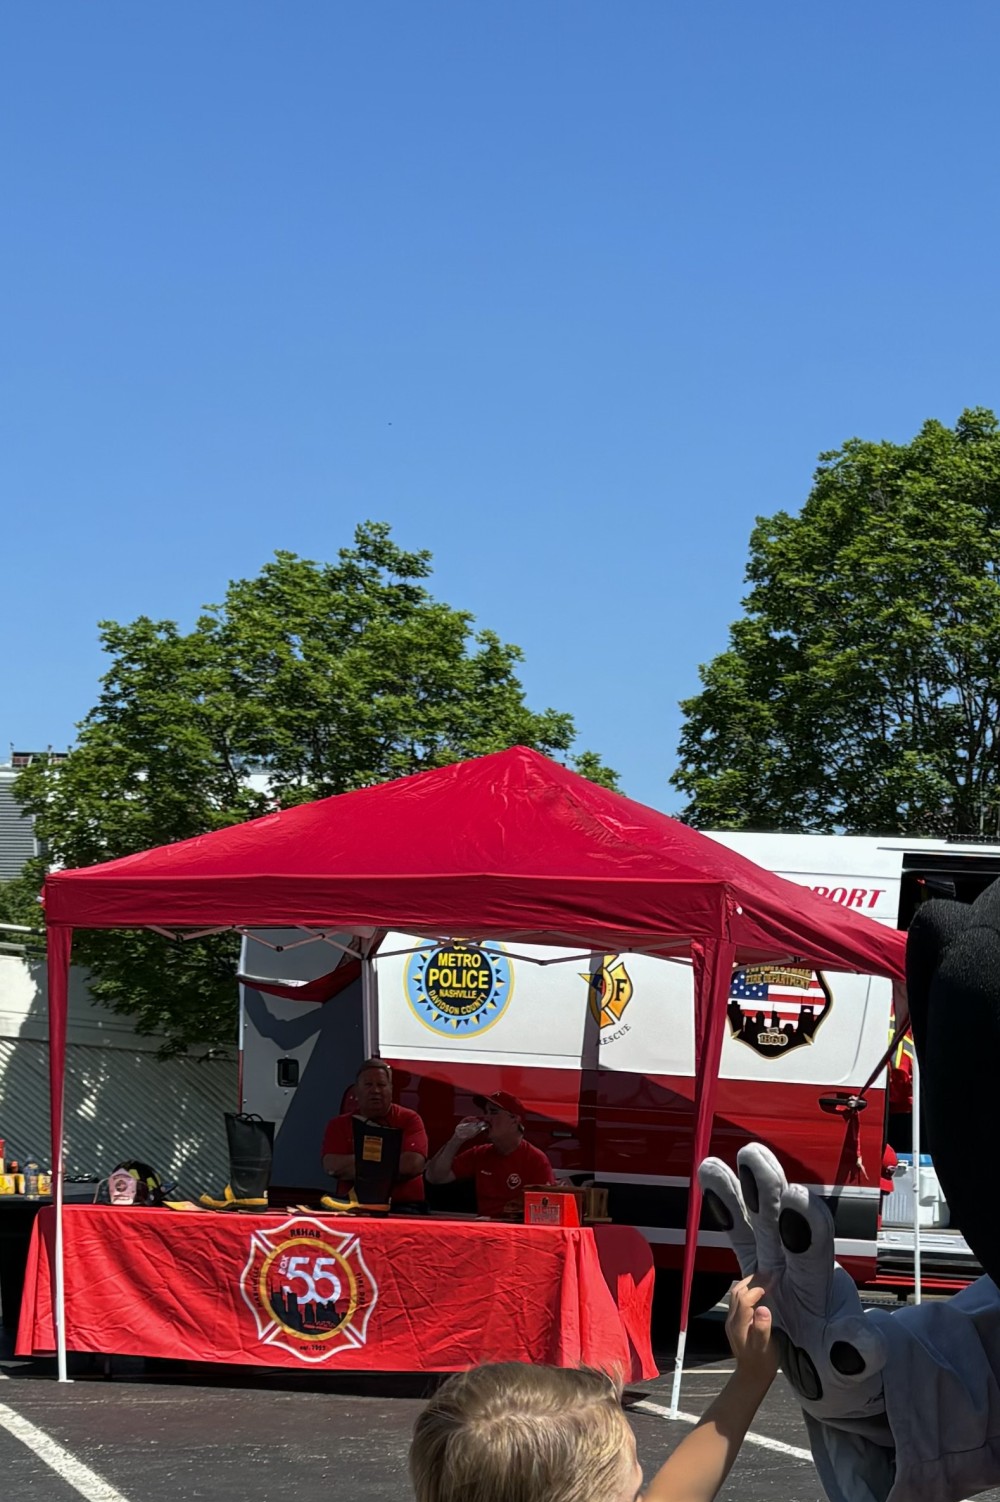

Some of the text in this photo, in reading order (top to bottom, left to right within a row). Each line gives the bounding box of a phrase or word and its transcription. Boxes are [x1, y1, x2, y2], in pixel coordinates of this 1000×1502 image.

[438, 953, 482, 967] METRO
[428, 968, 489, 989] POLICE
[429, 989, 488, 1015] DAVIDSON COUNTY
[439, 988, 478, 999] NASHVILLE
[290, 1228, 321, 1239] REHAB
[278, 1255, 341, 1305] BOX 55
